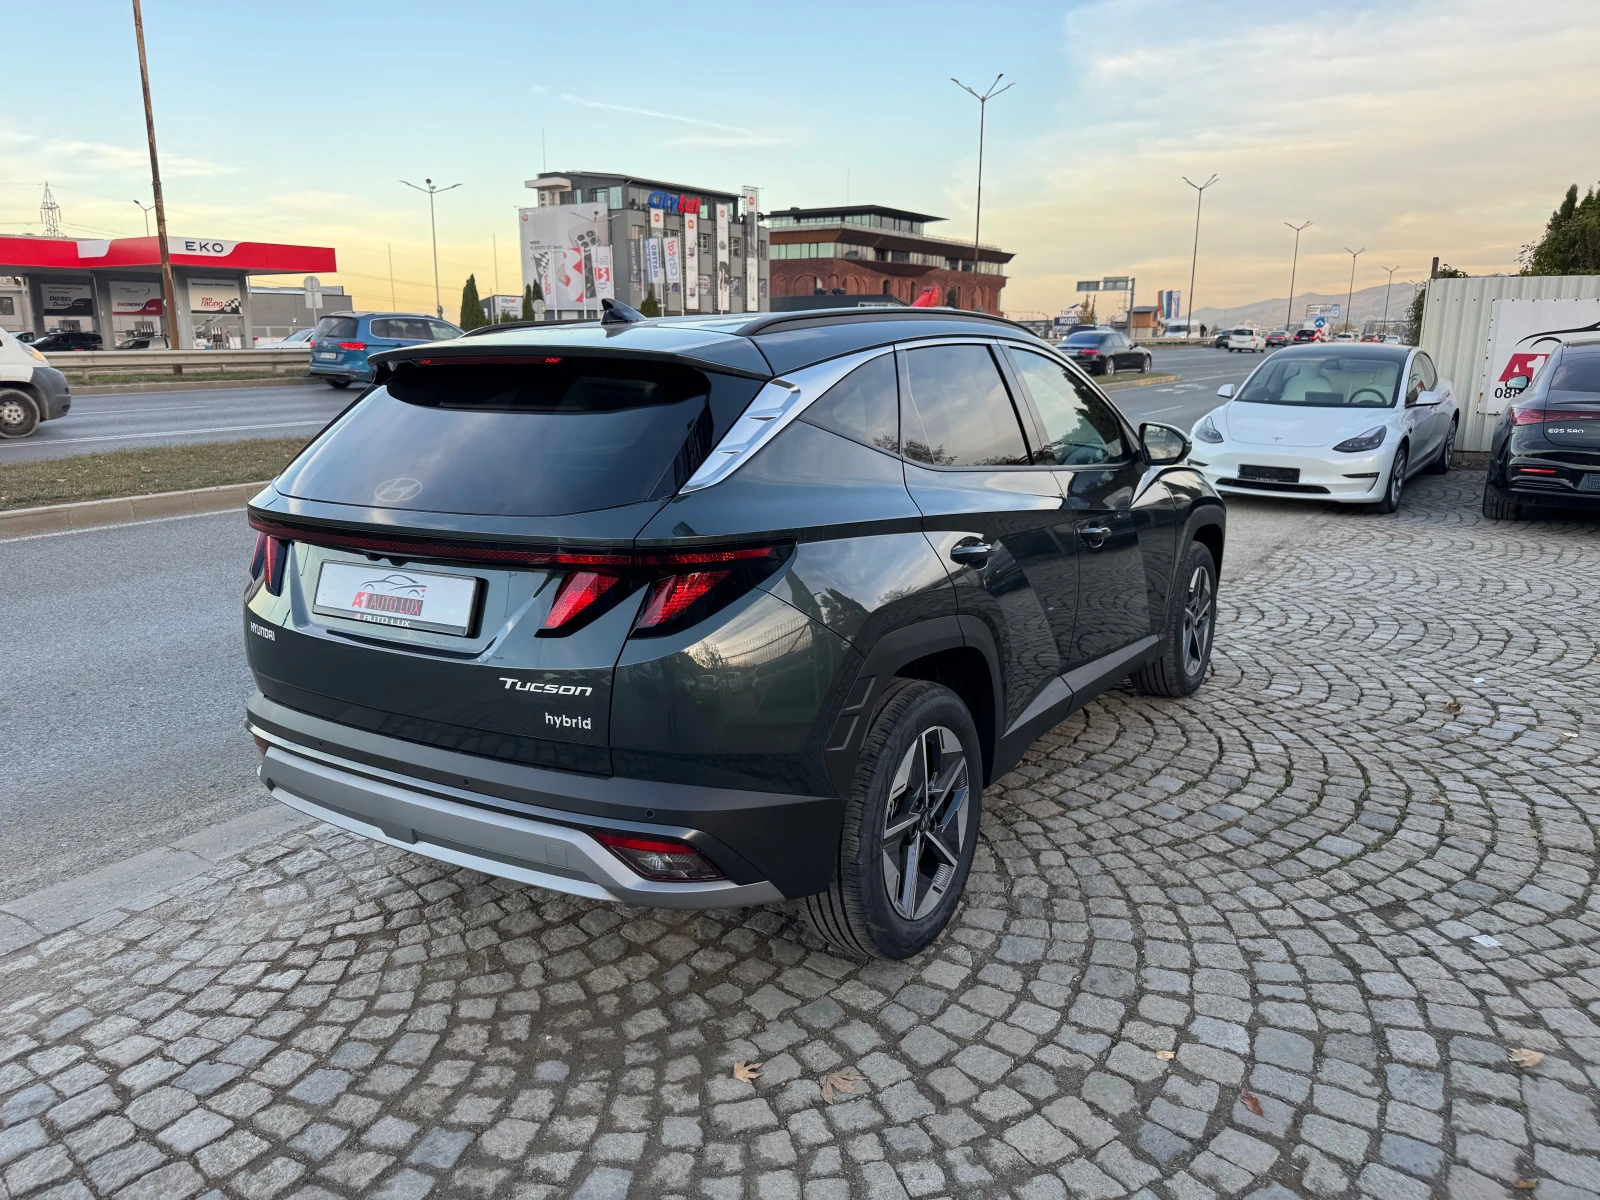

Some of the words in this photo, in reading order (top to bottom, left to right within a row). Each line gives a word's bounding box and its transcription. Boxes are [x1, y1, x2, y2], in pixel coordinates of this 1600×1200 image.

[185, 241, 224, 253] EKO
[370, 595, 398, 612] AUTO
[399, 598, 421, 616] LUX
[363, 614, 389, 624] AUTO
[390, 618, 411, 628] LUX
[250, 621, 276, 642] HYUNDAI
[545, 712, 592, 730] hybrid
